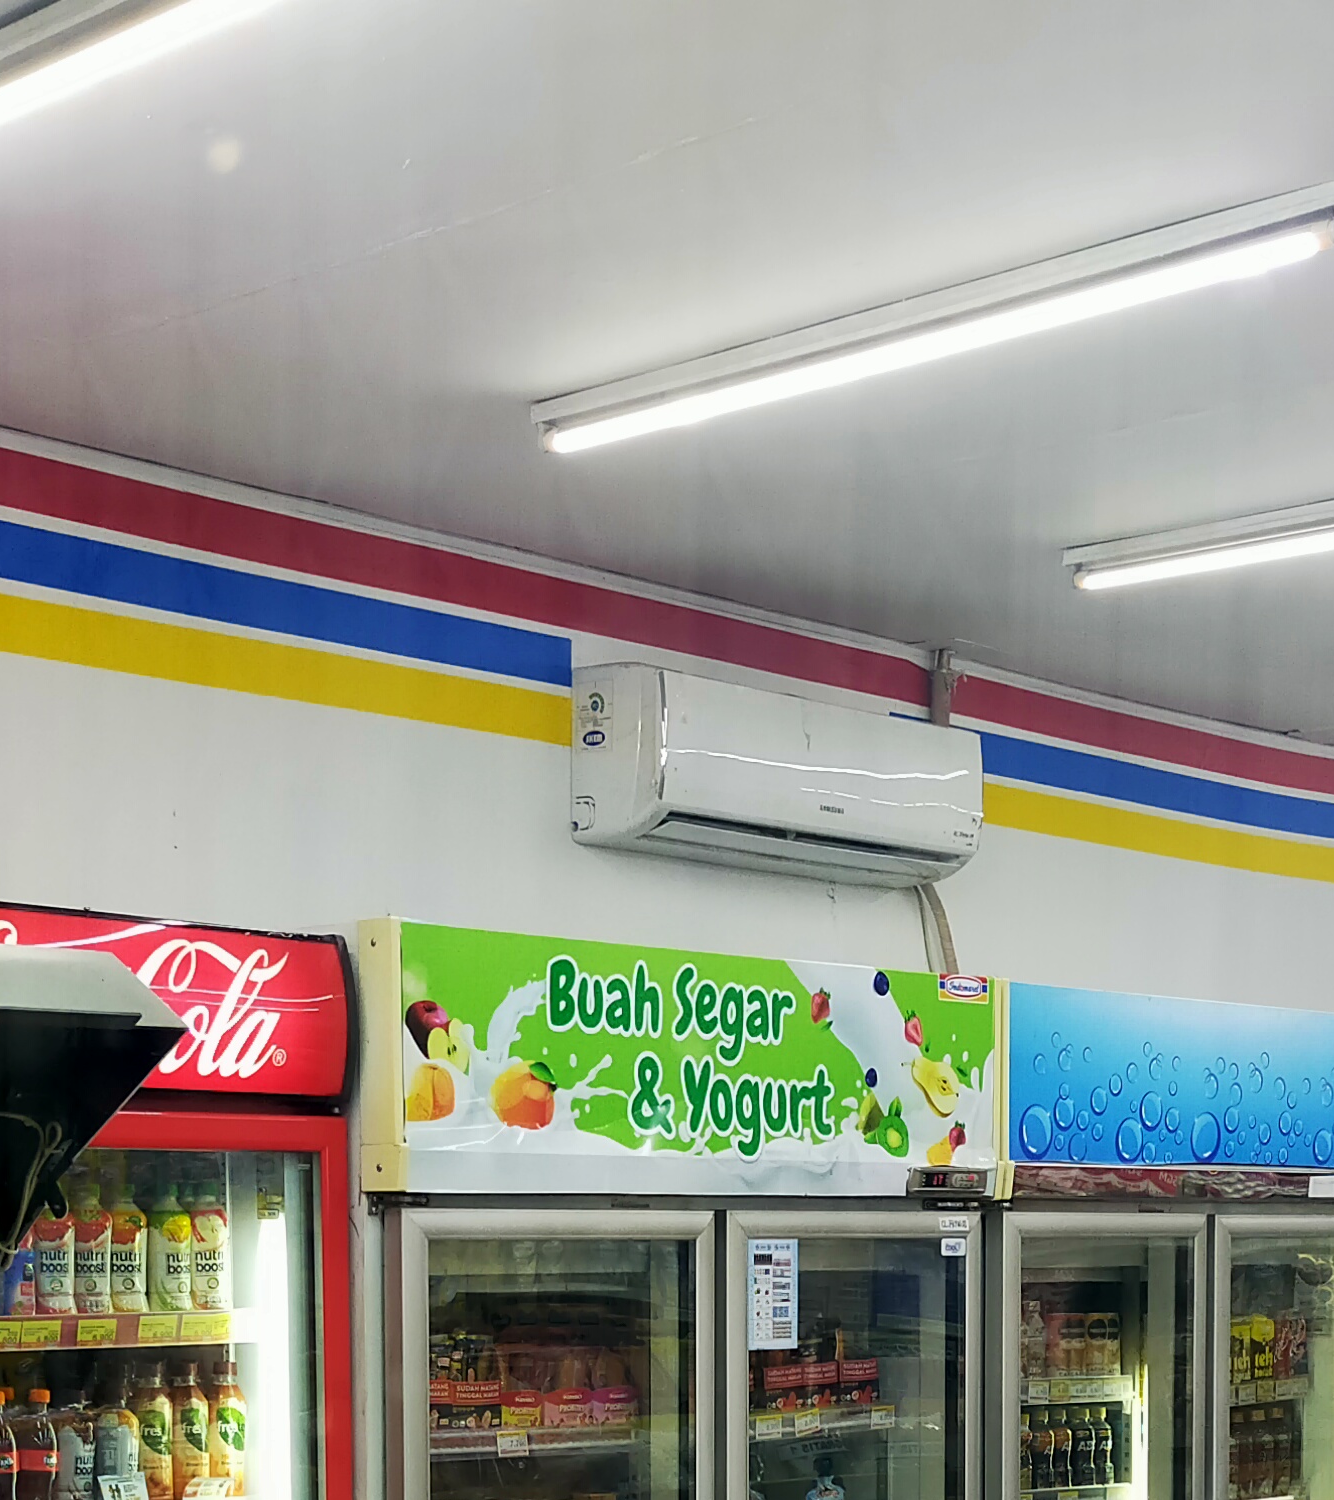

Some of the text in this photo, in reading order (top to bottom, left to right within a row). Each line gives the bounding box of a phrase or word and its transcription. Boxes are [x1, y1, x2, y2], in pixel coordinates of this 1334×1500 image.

[548, 956, 794, 1065] Buah Segar
[630, 1053, 833, 1158] & Yogurt
